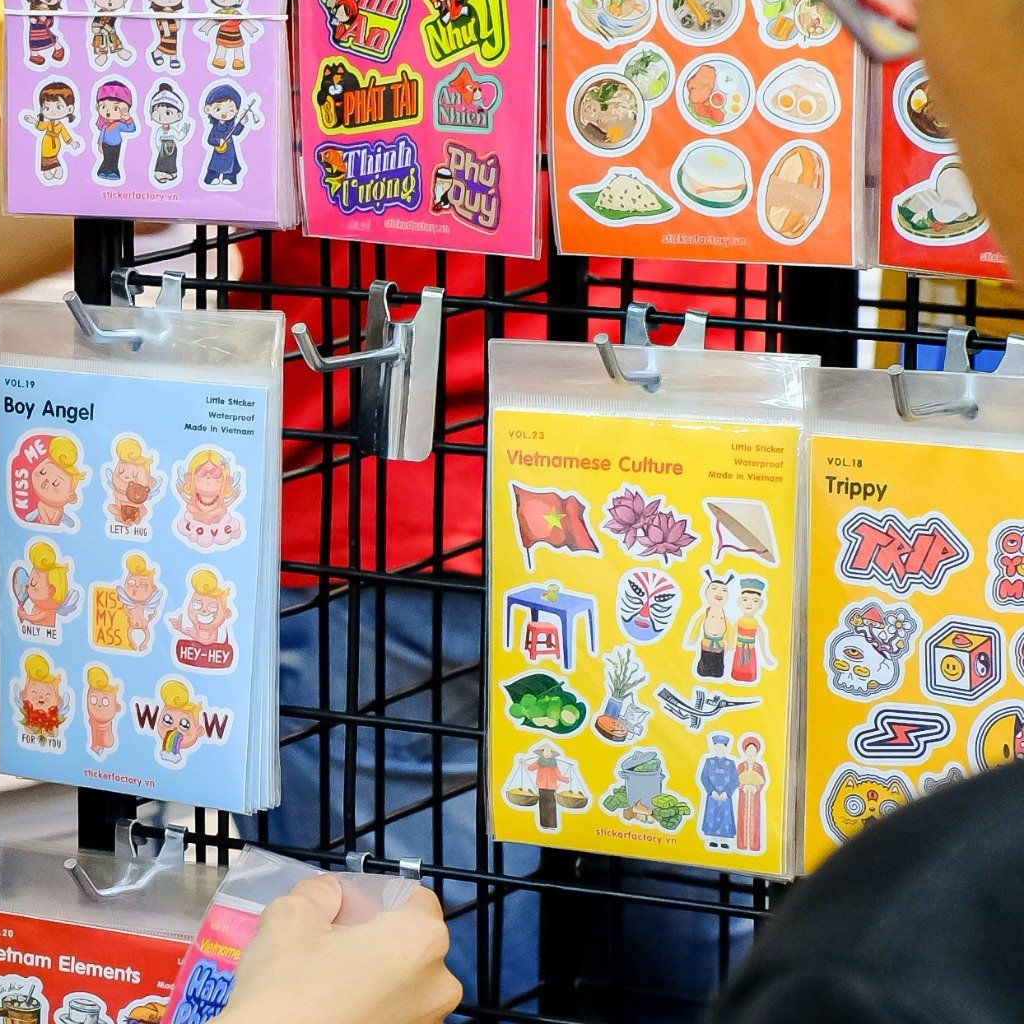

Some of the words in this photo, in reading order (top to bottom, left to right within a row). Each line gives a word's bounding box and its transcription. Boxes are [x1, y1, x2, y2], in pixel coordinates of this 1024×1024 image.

[343, 76, 386, 126] PHÁT
[391, 70, 417, 117] TÀI
[4, 378, 36, 389] VOL.19
[4, 396, 35, 420] Boy
[42, 400, 95, 424] Angel
[205, 397, 225, 406] Little
[228, 398, 256, 407] Sticker
[208, 411, 255, 423] Waterproof
[184, 423, 207, 433] Made
[221, 426, 255, 436] Vietnam
[508, 430, 545, 440] VOL.23
[24, 438, 48, 464] ME
[731, 443, 752, 452] Little
[755, 444, 784, 454] Sticker
[506, 449, 611, 471] Vietnamese
[618, 456, 684, 476] Culture
[734, 458, 784, 469] Waterproof
[827, 457, 863, 468] VOL.18
[708, 471, 733, 480] Made
[747, 473, 783, 483] Vietnam
[14, 468, 30, 510] KISS
[826, 475, 888, 502] Trippy
[134, 527, 148, 537] HUG
[850, 522, 959, 583] TRIP
[96, 610, 116, 627] MY
[21, 625, 41, 637] ONLY
[46, 627, 57, 639] ME
[96, 628, 123, 646] ASS
[180, 645, 230, 664] HEY-HEY
[21, 733, 36, 744] FOR
[47, 738, 62, 749] YOU
[595, 828, 677, 845] stickerfactory.vn
[58, 955, 141, 984] Elements
